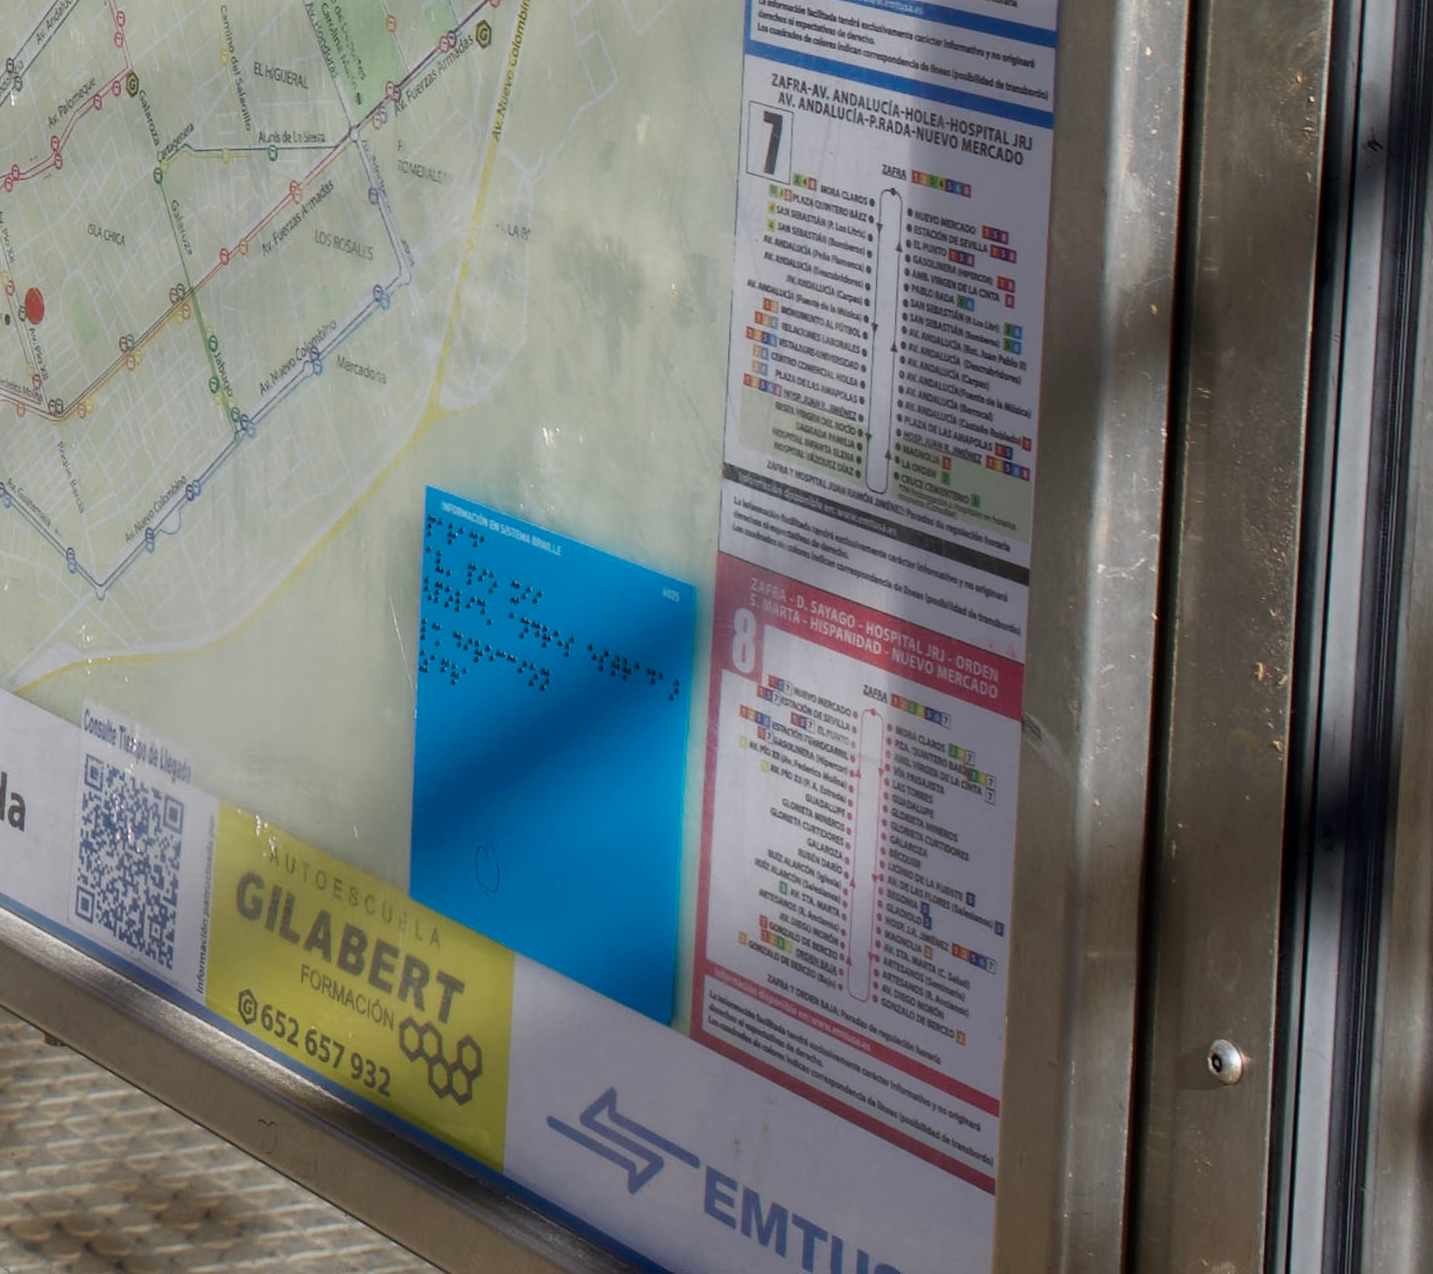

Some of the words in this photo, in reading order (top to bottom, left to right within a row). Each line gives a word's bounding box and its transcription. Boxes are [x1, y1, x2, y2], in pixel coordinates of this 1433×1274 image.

[763, 111, 783, 175] 7
[960, 138, 1024, 166] MERCADO
[1012, 133, 1033, 151] JRJ
[732, 607, 756, 674] 8
[809, 614, 882, 656] HISPANIDAD
[892, 648, 934, 675] NUEVO
[936, 664, 998, 700] MERCADO
[810, 599, 856, 628] SAYAGO
[955, 657, 999, 682] ORDEN
[148, 741, 160, 767] de
[268, 846, 442, 951] AUTOESCUELA
[235, 872, 466, 1025] GILABERT
[300, 964, 395, 1030] FORMACIÓN
[260, 1003, 299, 1048] 652
[304, 1024, 346, 1068] 657
[350, 1052, 392, 1098] 932
[703, 1165, 905, 1274] EMTU
